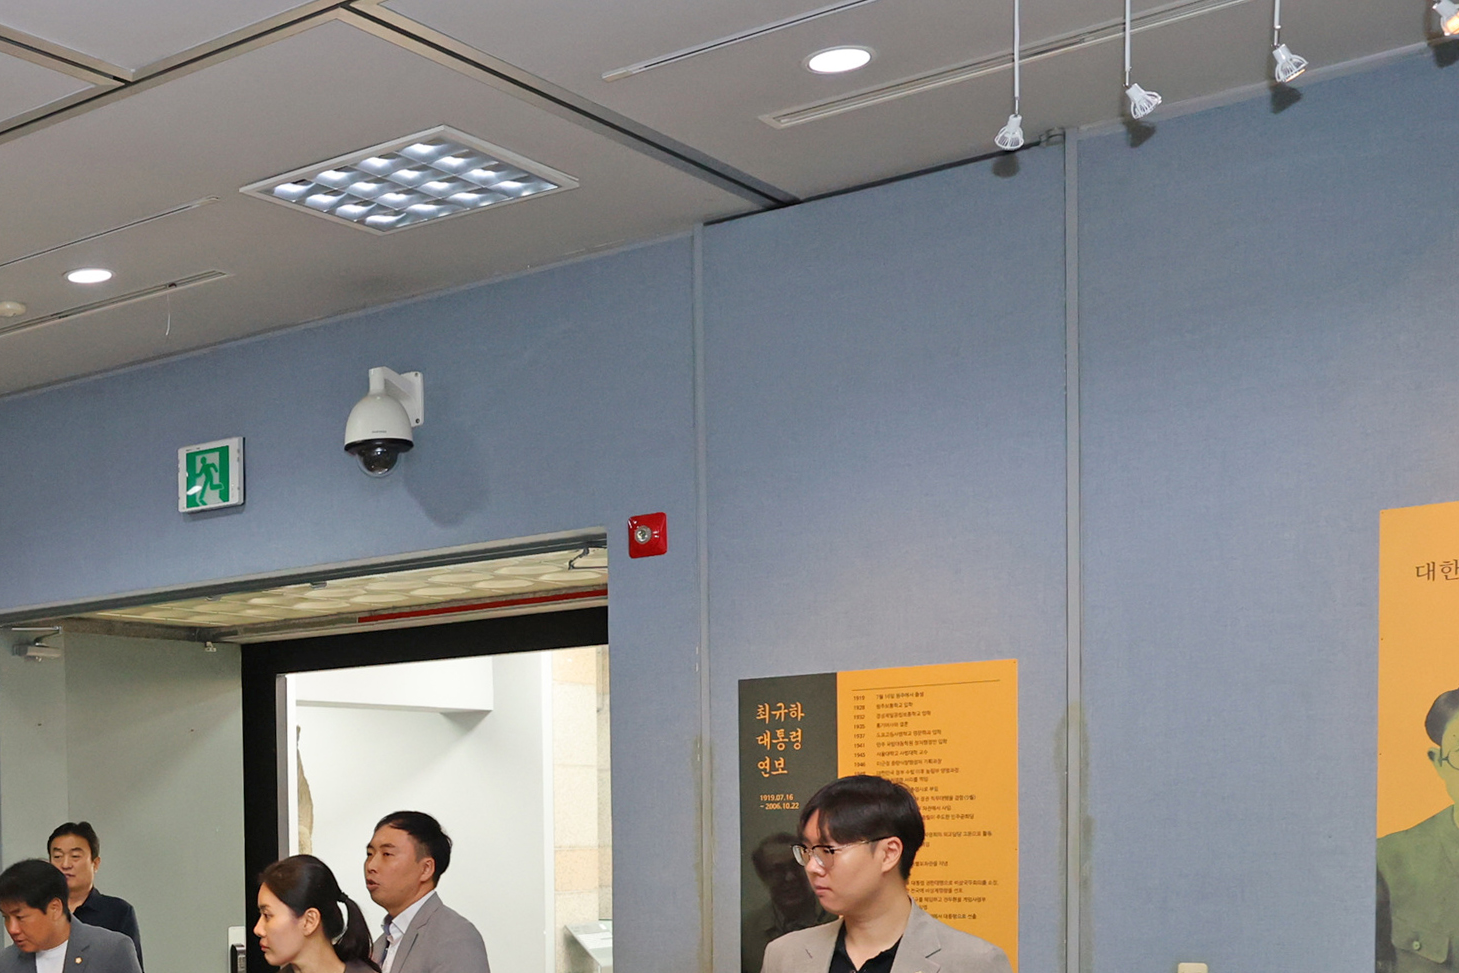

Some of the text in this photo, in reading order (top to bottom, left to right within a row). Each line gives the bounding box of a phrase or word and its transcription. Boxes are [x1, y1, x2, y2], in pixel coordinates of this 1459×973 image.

[1415, 559, 1459, 581] 대한
[756, 702, 805, 724] 최규하
[756, 728, 802, 751] 대통령
[757, 756, 788, 778] 연보
[765, 802, 800, 810] 2006.10.22
